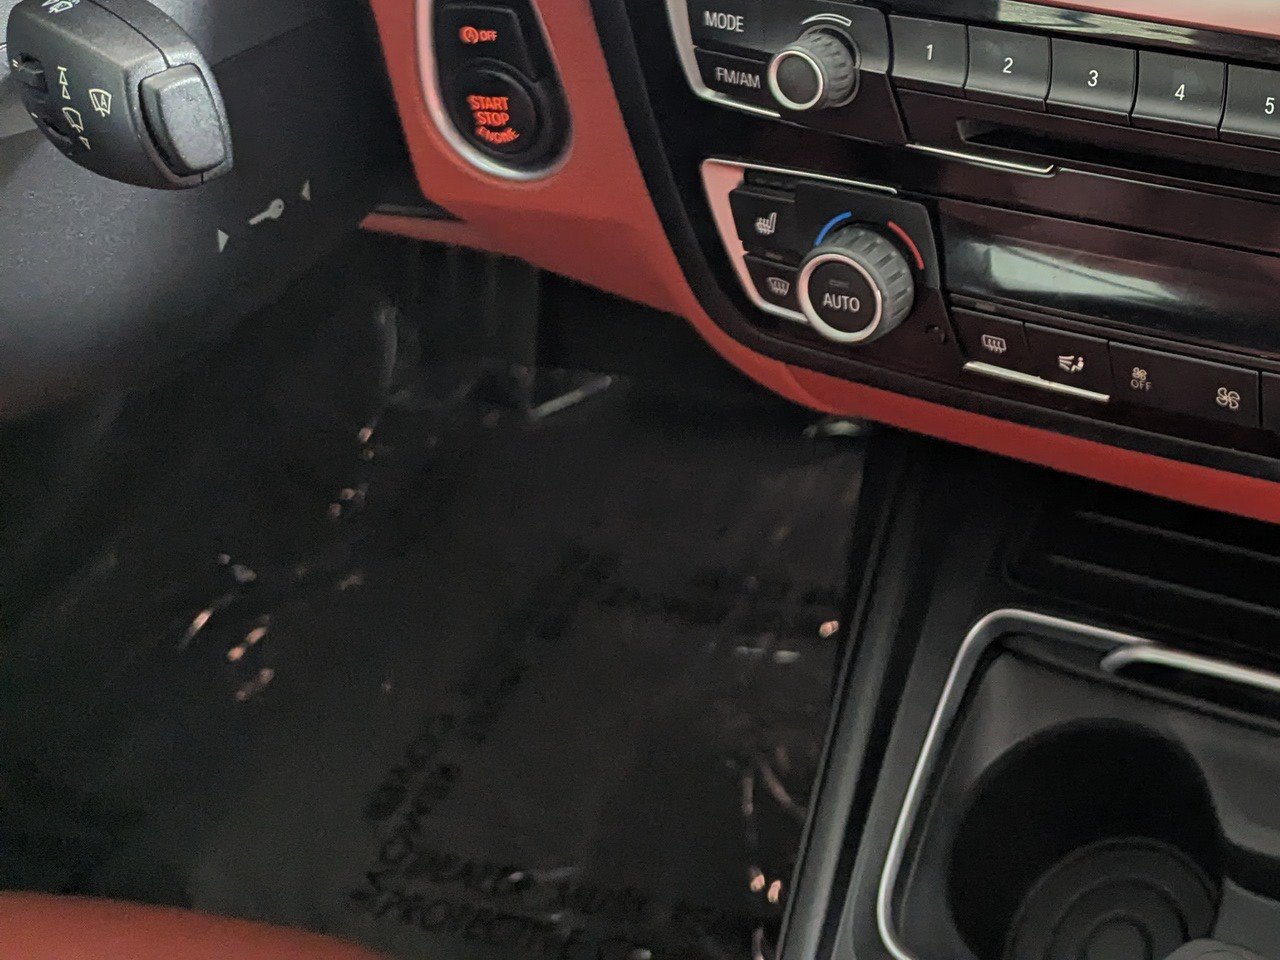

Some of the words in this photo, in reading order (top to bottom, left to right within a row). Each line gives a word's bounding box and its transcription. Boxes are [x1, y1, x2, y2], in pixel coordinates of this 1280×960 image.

[704, 10, 745, 33] MODE
[480, 30, 498, 42] OFF
[925, 44, 934, 61] 1
[1002, 57, 1014, 74] 2
[714, 65, 761, 90] FM/AM
[1086, 69, 1100, 88] 3
[1173, 83, 1186, 101] 4
[467, 95, 509, 111] START
[1263, 96, 1276, 115] 5
[475, 111, 511, 127] STOP
[823, 292, 861, 313] AUTO
[1130, 378, 1152, 392] OFF
